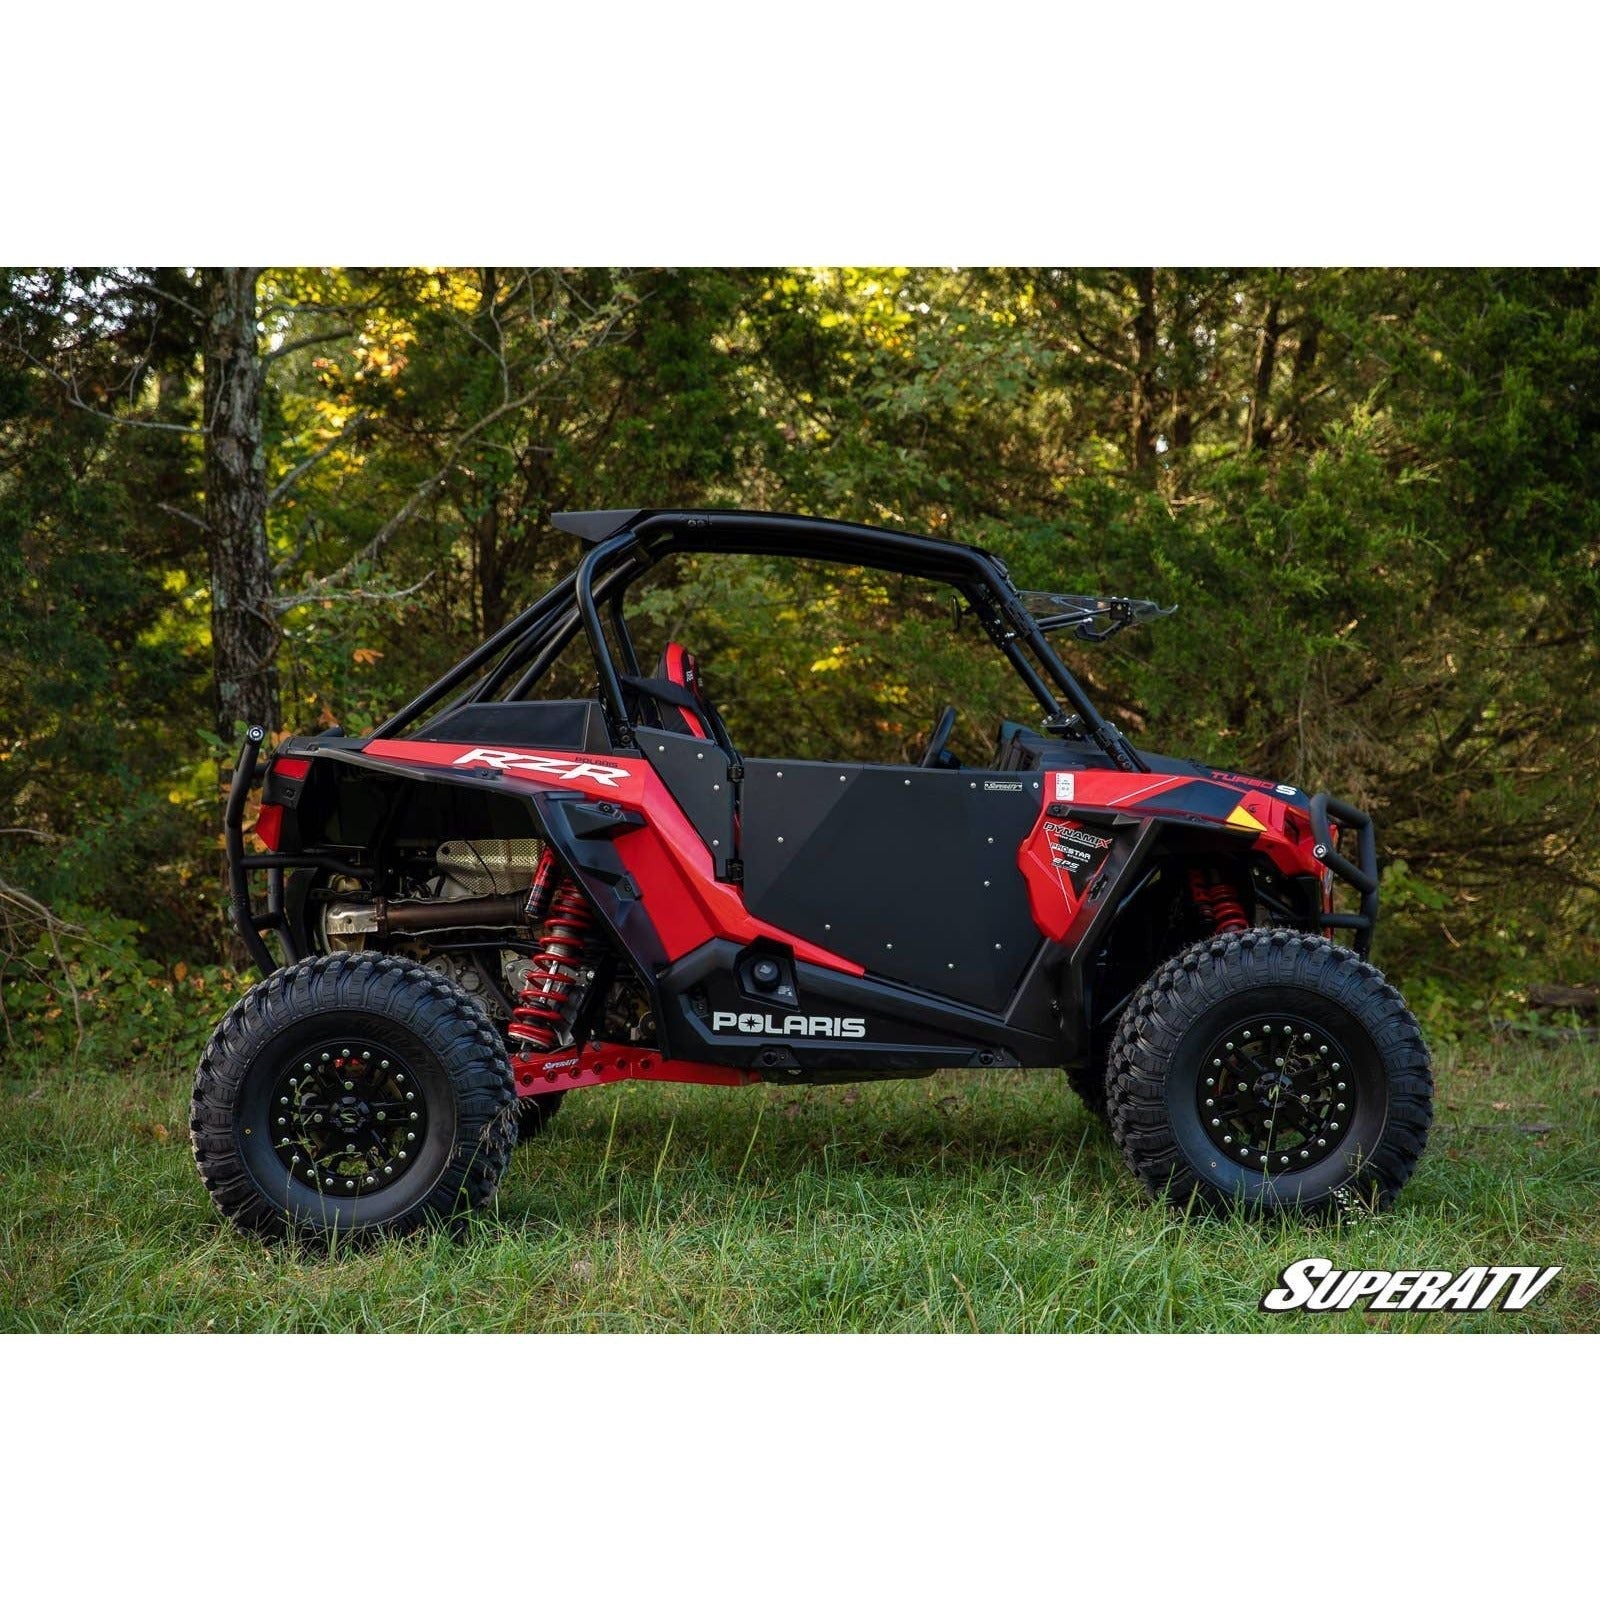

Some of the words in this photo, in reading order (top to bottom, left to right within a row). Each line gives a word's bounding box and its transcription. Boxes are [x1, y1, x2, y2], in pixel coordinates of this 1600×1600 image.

[452, 748, 631, 788] RZR
[574, 756, 618, 768] POLARIS
[1211, 769, 1276, 790] TURBO
[1275, 784, 1297, 796] S
[1043, 821, 1113, 849] DYNAMIX
[712, 1011, 866, 1038] POLARIS
